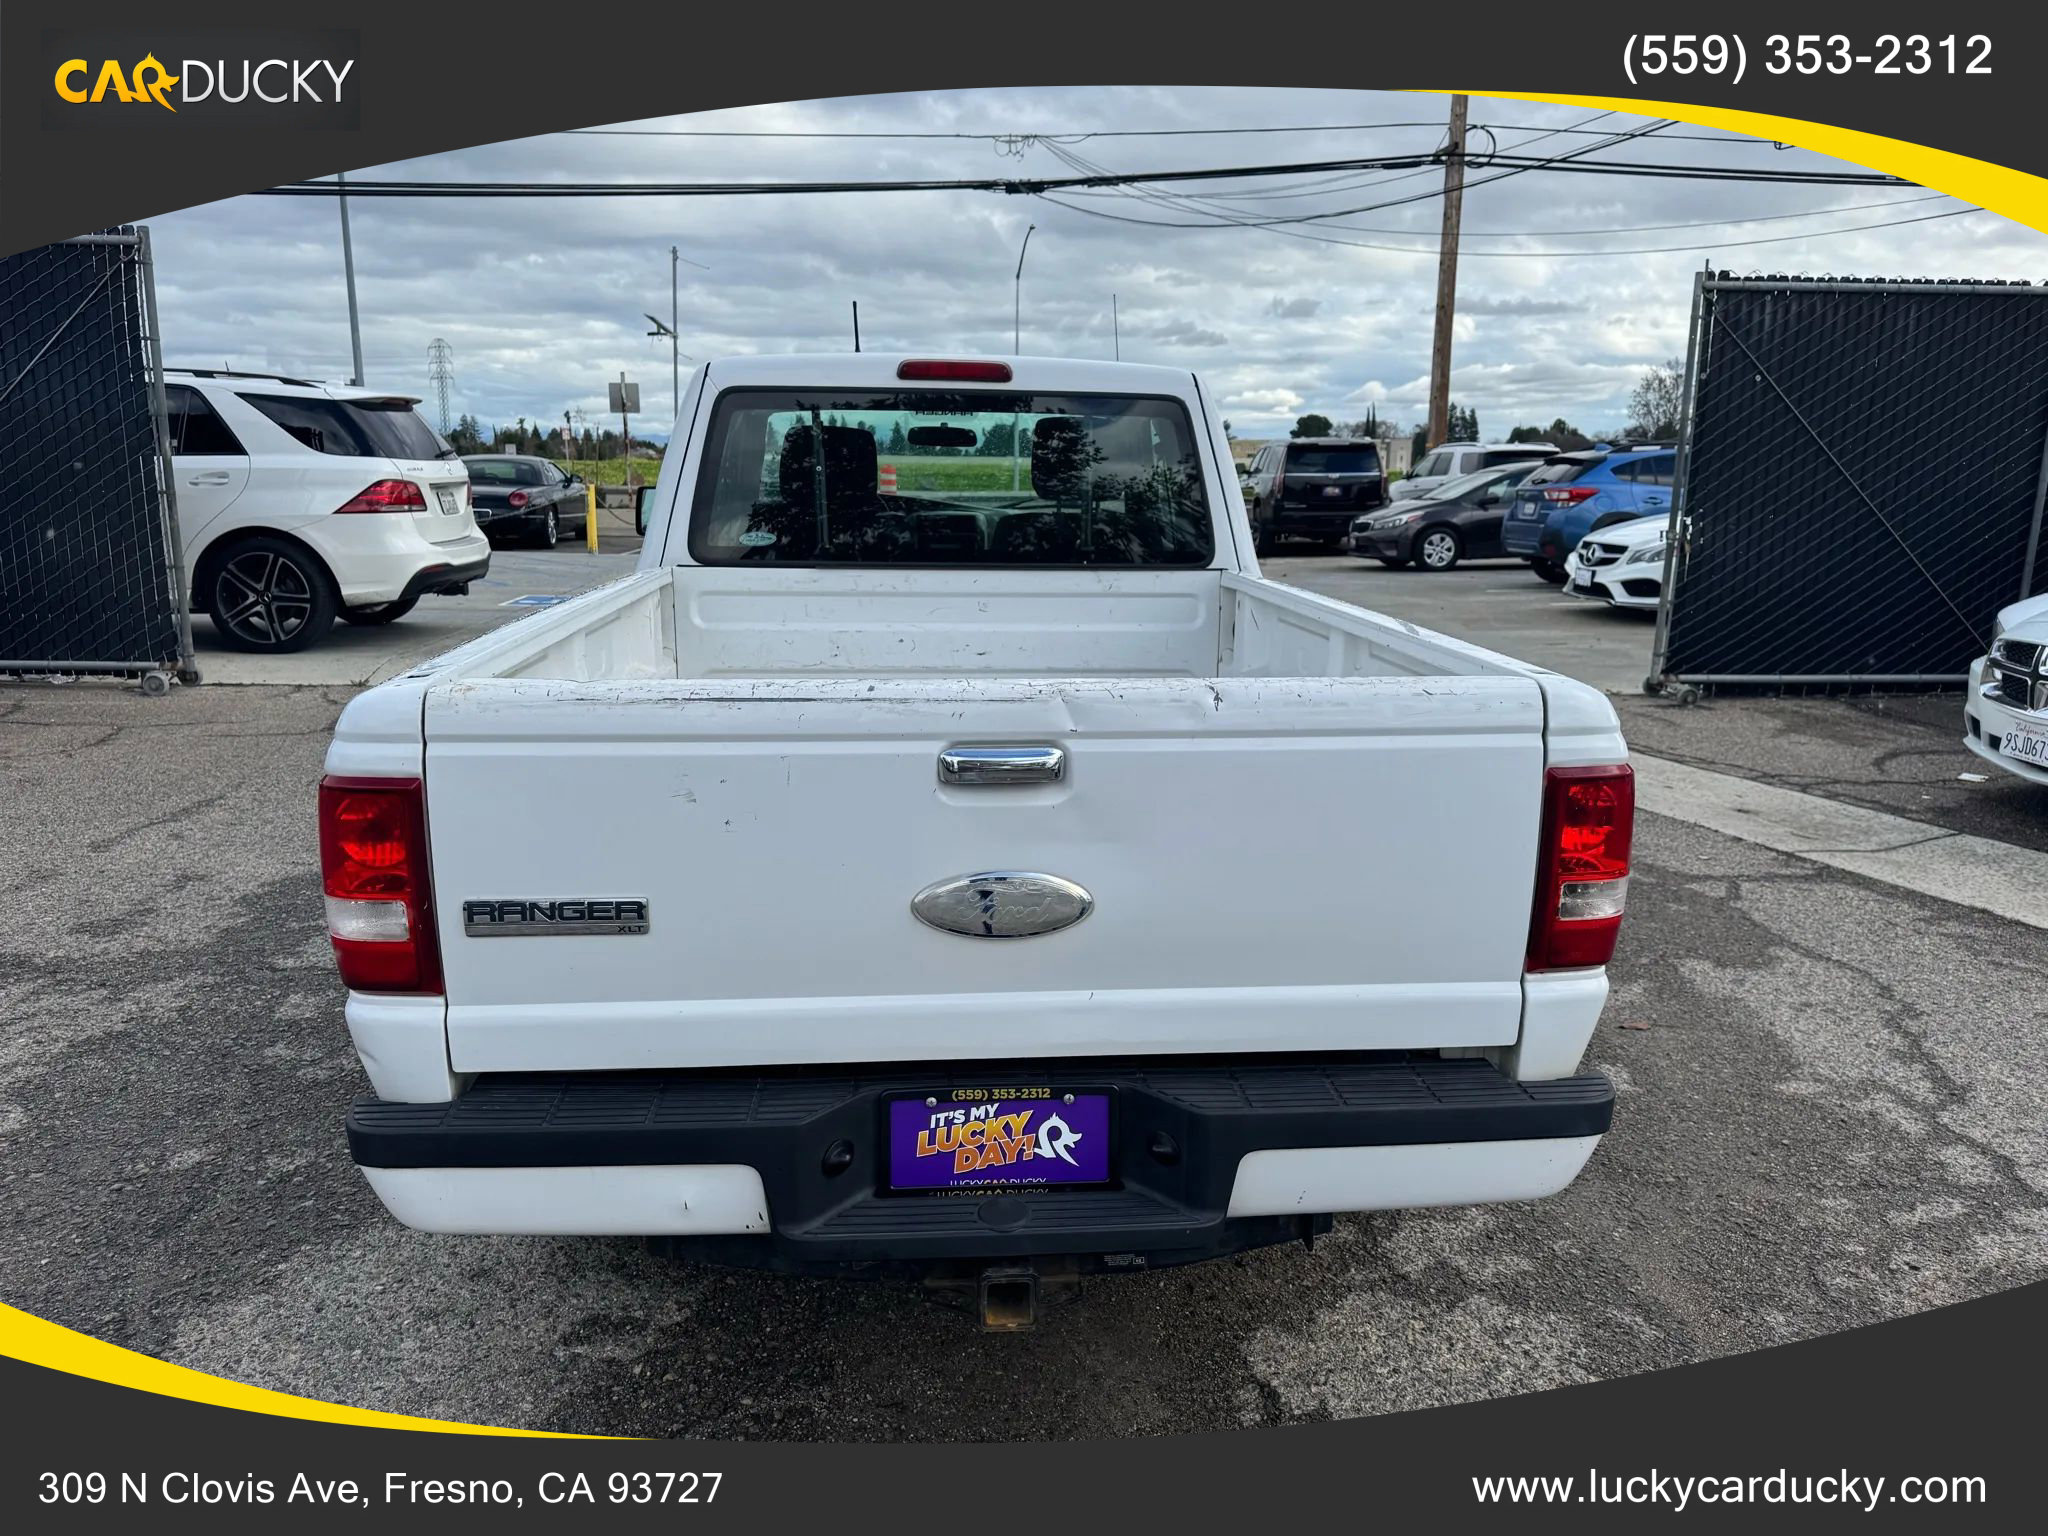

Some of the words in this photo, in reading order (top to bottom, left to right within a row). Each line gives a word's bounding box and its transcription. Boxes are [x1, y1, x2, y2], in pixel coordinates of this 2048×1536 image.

[466, 900, 645, 923] RANGER
[616, 924, 645, 933] XLT
[951, 1089, 989, 1102] (559)
[992, 1087, 1051, 1100] 353-2312
[929, 1109, 966, 1129] IT'S
[969, 1102, 1000, 1122] MY
[916, 1110, 1034, 1157] LUCKY
[953, 1133, 1036, 1174] DAY!
